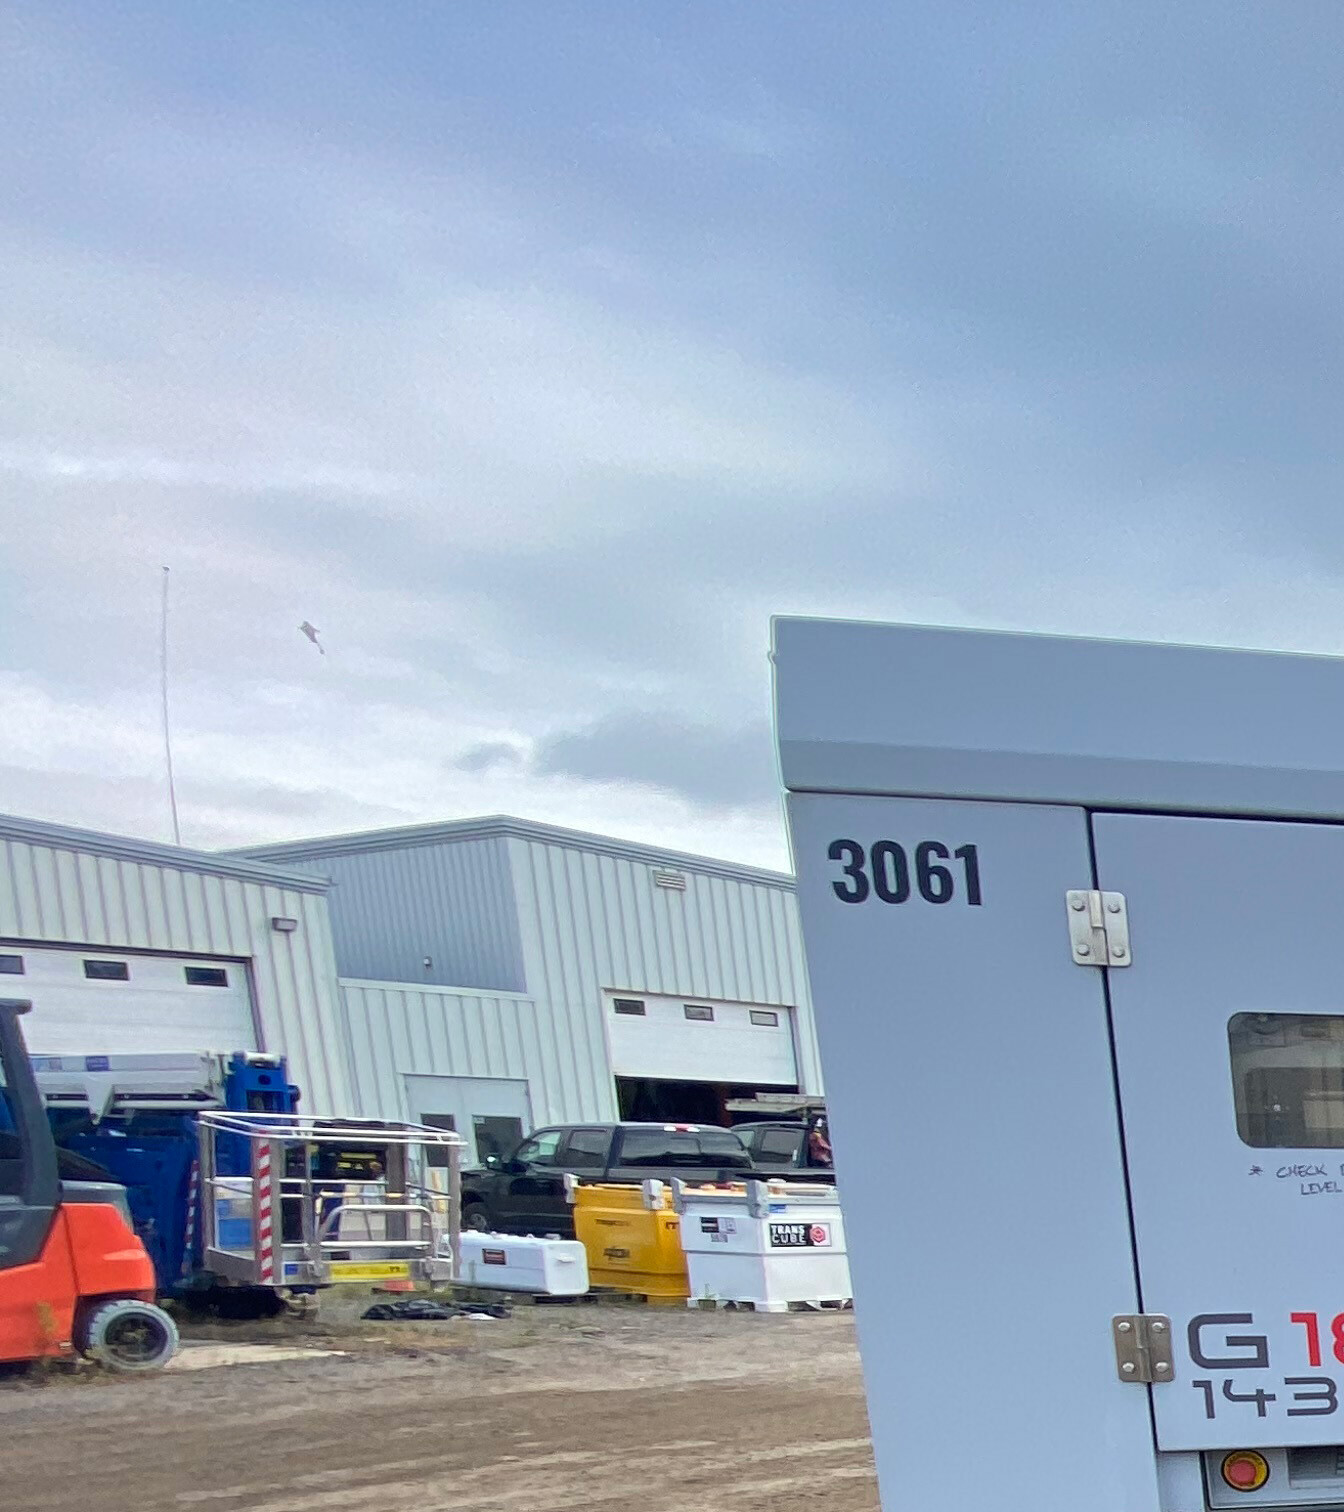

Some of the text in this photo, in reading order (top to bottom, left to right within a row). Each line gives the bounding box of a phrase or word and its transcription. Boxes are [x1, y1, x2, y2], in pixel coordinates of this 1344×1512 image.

[828, 839, 982, 906] 3061
[1275, 1163, 1328, 1179] CHECK
[1300, 1181, 1344, 1196] LEVEL
[771, 1225, 805, 1235] TRANS
[771, 1234, 807, 1243] CUBE
[1192, 1376, 1338, 1419] 143
